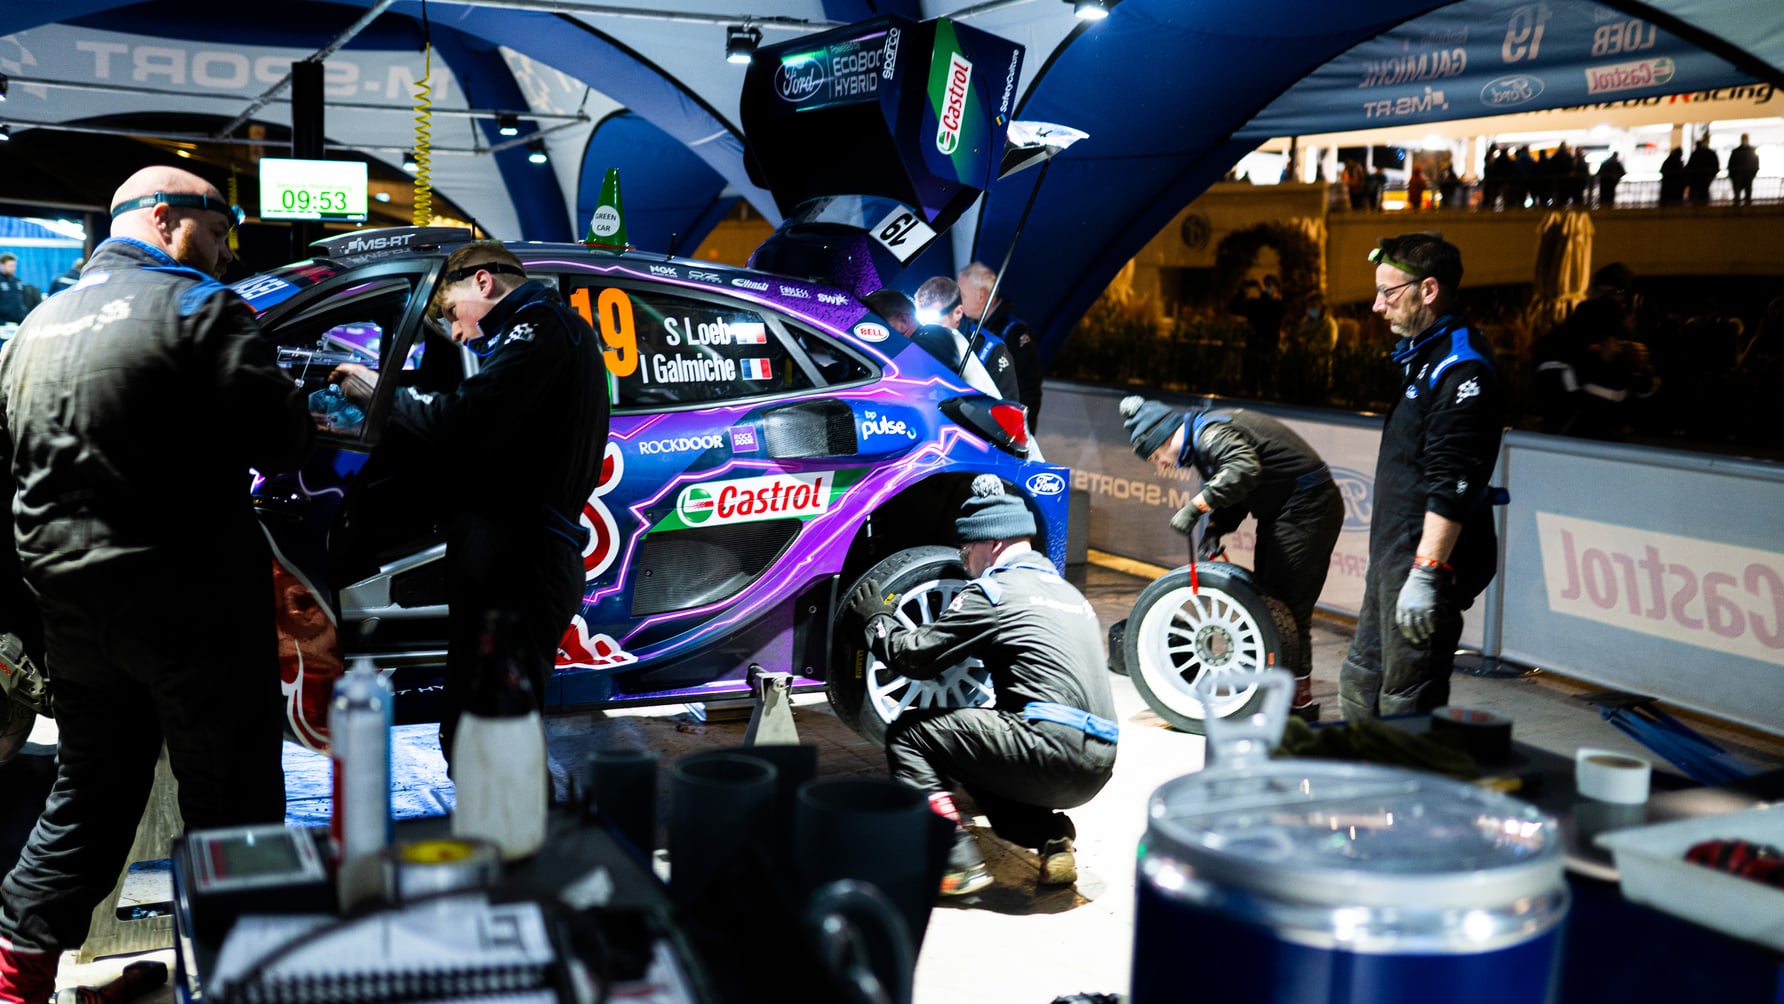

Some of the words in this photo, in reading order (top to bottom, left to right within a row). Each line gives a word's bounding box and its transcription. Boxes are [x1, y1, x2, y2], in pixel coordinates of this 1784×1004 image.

[882, 27, 899, 80] sparco
[782, 63, 816, 96] Ford
[834, 72, 878, 97] HYBRID
[943, 61, 969, 131] Castrol
[282, 190, 347, 211] 09:53
[595, 213, 617, 221] GREEN
[879, 213, 919, 247] 19
[649, 265, 677, 275] NGK
[570, 287, 639, 377] 19
[664, 316, 681, 346] S
[684, 317, 732, 345] Loeb
[860, 328, 884, 337] BELL
[653, 353, 736, 384] Galmiche
[865, 411, 877, 419] bp
[861, 417, 907, 440] pulse
[638, 435, 724, 455] ROCKDOOR
[1034, 475, 1061, 493] Ford
[717, 476, 823, 519] Castrol
